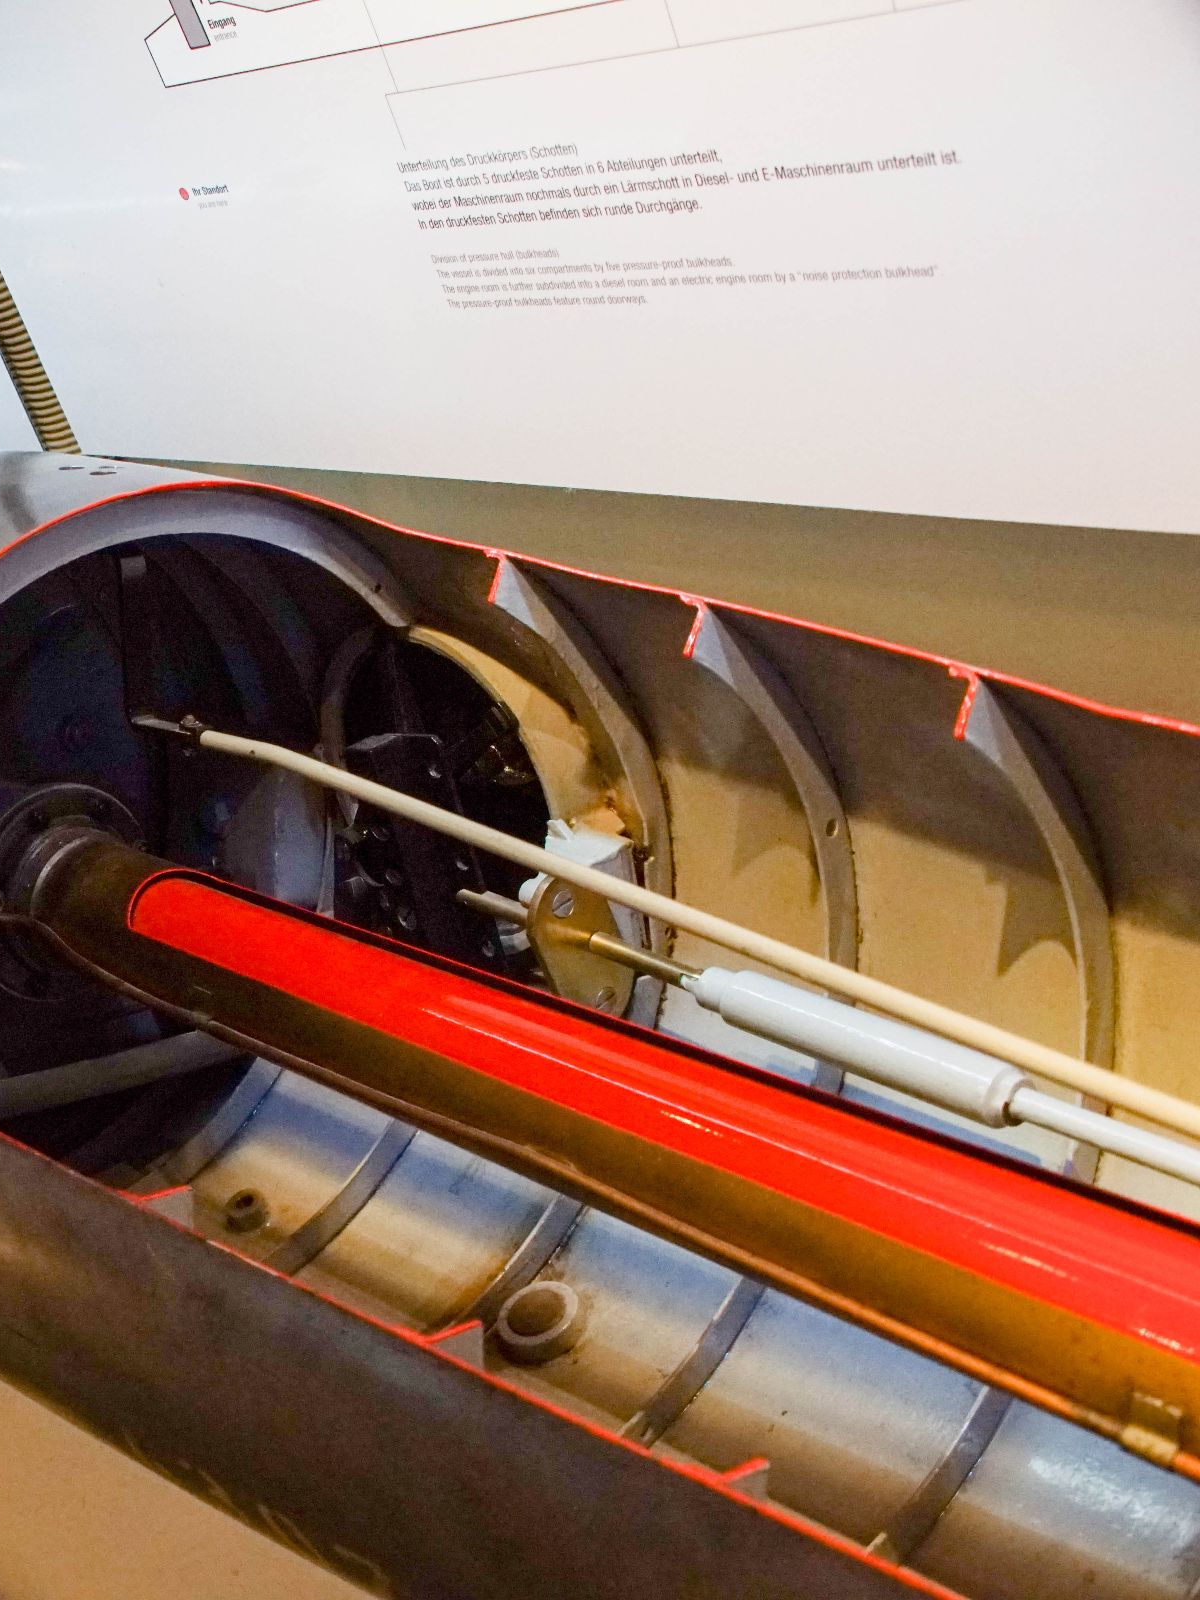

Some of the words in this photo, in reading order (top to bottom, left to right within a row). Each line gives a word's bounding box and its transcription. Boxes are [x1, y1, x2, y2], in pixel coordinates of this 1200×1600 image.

[208, 16, 236, 29] Eingang
[397, 158, 449, 174] Unterteilung
[450, 156, 466, 168] des
[466, 149, 528, 166] Druckkörpers
[529, 142, 578, 160] (Schotten)
[404, 180, 421, 192] Das
[422, 178, 442, 190] Boot
[444, 177, 455, 189] ist
[456, 174, 481, 188] durch
[482, 173, 490, 184] 5
[491, 169, 540, 184] druckfeste
[540, 164, 582, 180] Schotten
[585, 163, 595, 174] in
[597, 161, 605, 173] 6
[607, 156, 667, 173] Abteilungen
[670, 149, 722, 167] unterteilt,
[412, 199, 437, 211] wobei
[438, 198, 452, 209] der
[453, 191, 524, 208] Maschinenraum
[525, 187, 571, 202] nochmals
[573, 183, 602, 198] durch
[603, 182, 619, 194] ein
[620, 176, 680, 193] Lärmschott
[681, 176, 693, 188] in
[694, 172, 733, 187] Diesel-
[737, 169, 759, 183] und
[762, 159, 874, 181] E-Maschinenraum
[877, 152, 937, 171] unterteilt
[202, 184, 229, 196] Standort
[417, 219, 428, 230] In
[428, 217, 445, 229] den
[445, 214, 497, 229] druckfesten
[497, 210, 537, 224] Schotten
[538, 208, 580, 222] befinden
[581, 206, 603, 218] sich
[604, 203, 634, 216] runde
[635, 199, 702, 215] Durchgänge.
[430, 254, 459, 264] Division
[460, 253, 467, 263] of
[468, 252, 499, 263] pressure
[500, 249, 514, 260] hull
[516, 248, 560, 260] (bulkheads)
[436, 269, 450, 279] The
[451, 268, 474, 278] vessel
[482, 267, 508, 277] divided
[510, 266, 524, 276] into
[537, 264, 592, 275] compartments
[593, 263, 604, 273] by
[605, 261, 621, 271] five
[622, 258, 684, 272] pressure-proof
[441, 284, 455, 294] The
[457, 283, 481, 294] engine
[481, 283, 500, 292] room
[509, 281, 533, 291] further
[535, 280, 577, 291] subdivided
[577, 280, 593, 289] into
[595, 280, 600, 288] a
[601, 278, 625, 288] diesel
[627, 278, 649, 287] room
[650, 276, 667, 286] and
[669, 277, 679, 286] an
[681, 275, 713, 286] electric
[716, 275, 747, 286] engine
[750, 274, 773, 283] room
[774, 272, 786, 284] by
[790, 274, 795, 282] a
[831, 268, 882, 282] protection
[447, 299, 460, 309] The
[461, 297, 512, 309] pressure-proof
[514, 297, 552, 307] bulkheads
[553, 296, 580, 306] feature
[583, 295, 606, 305] round
[607, 294, 648, 306] doorways.
